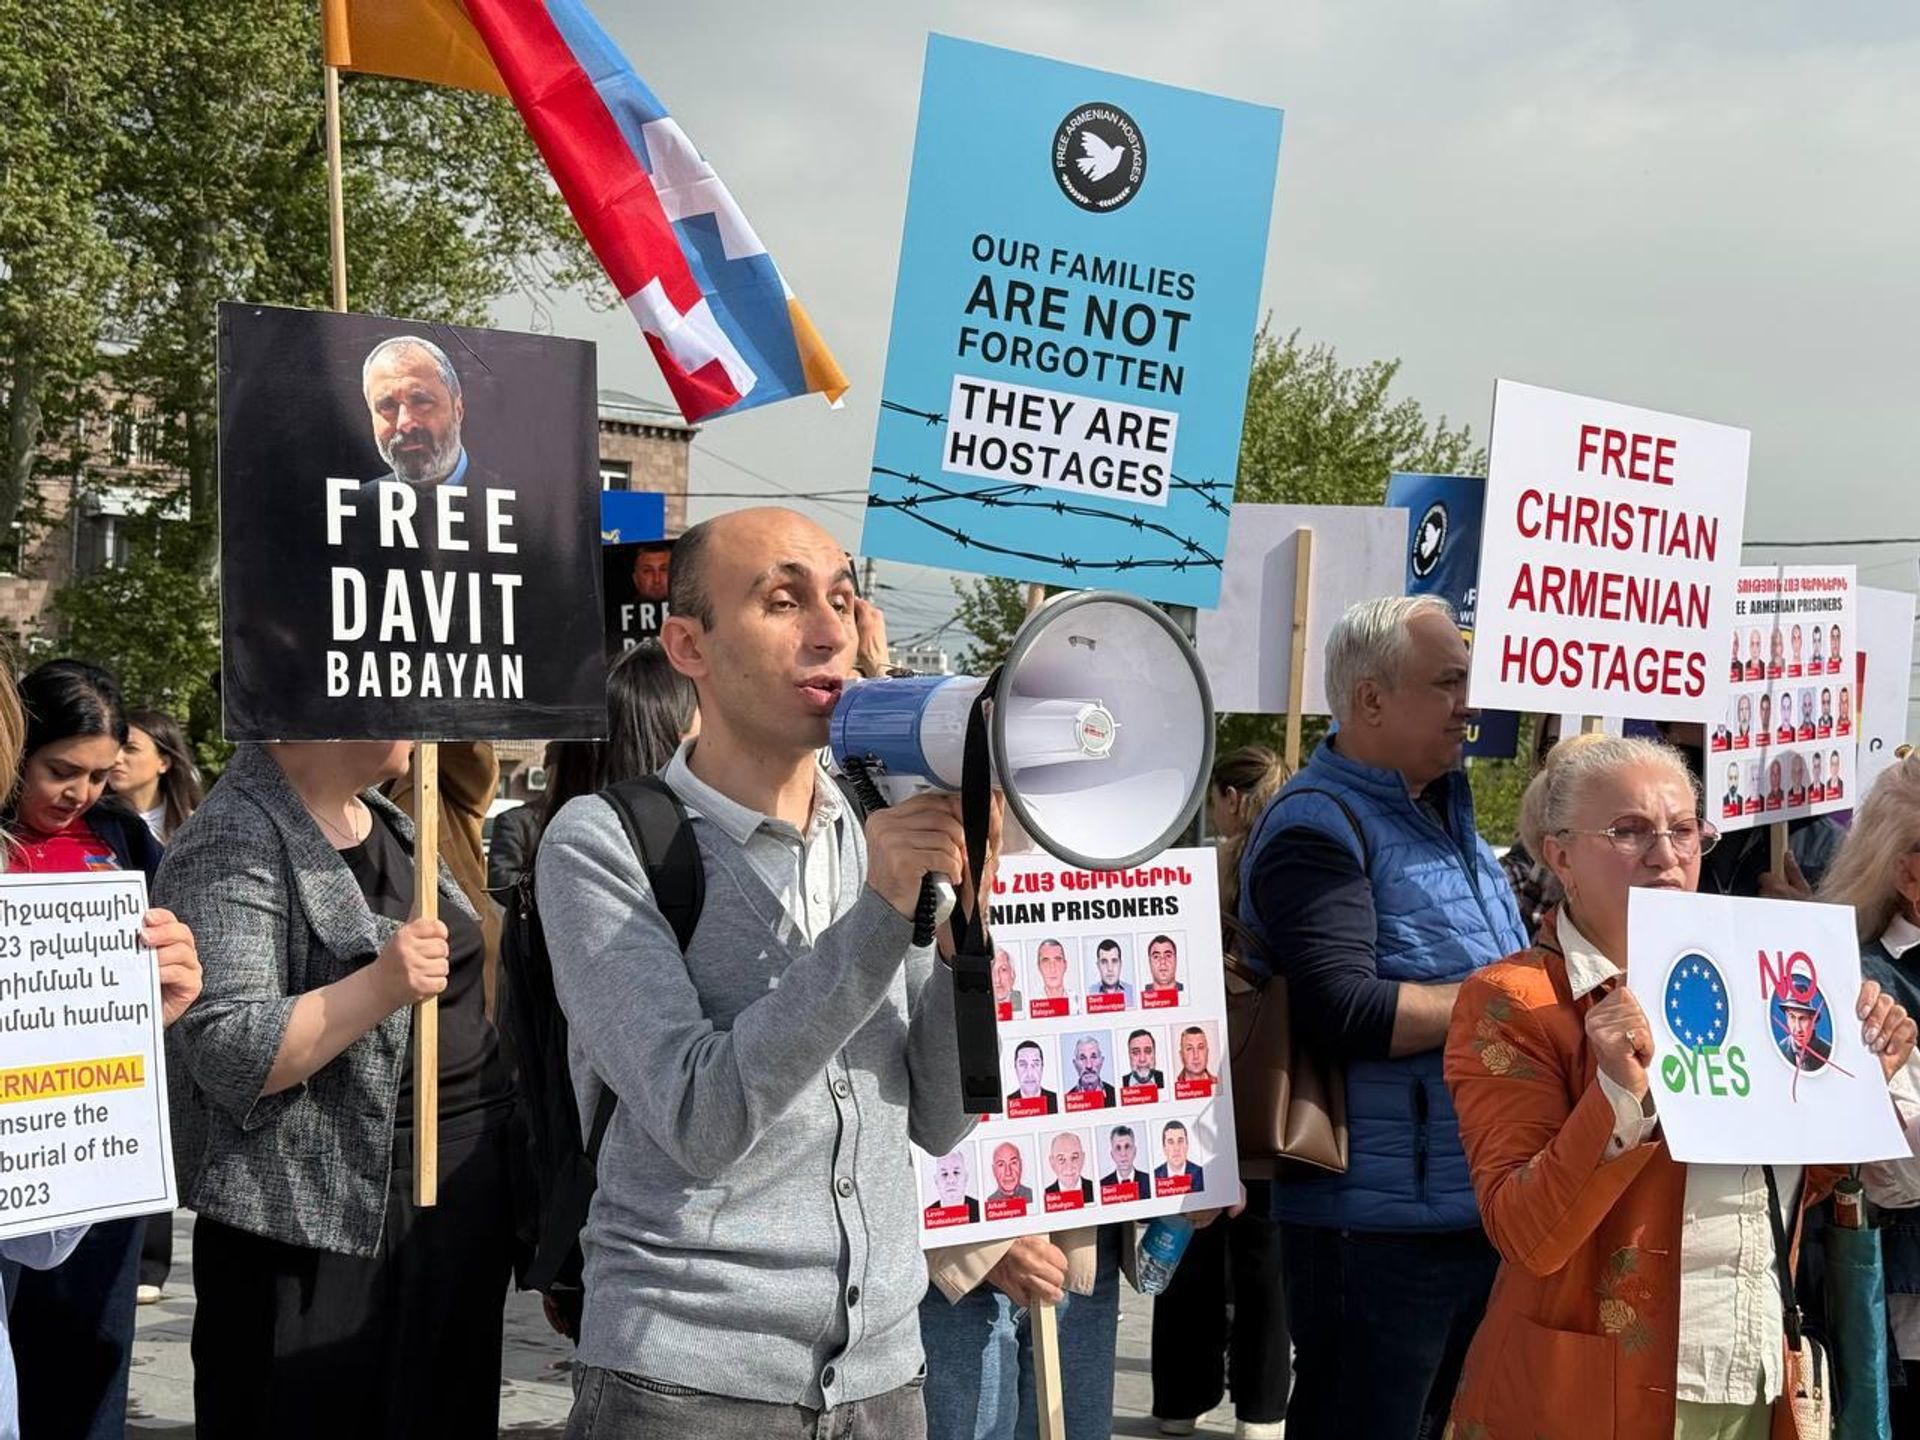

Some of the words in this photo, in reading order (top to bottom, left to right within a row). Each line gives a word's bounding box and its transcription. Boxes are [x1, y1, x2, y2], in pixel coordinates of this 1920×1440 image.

[1056, 134, 1070, 168] FREE
[1065, 109, 1119, 136] ARMENIAN
[1117, 118, 1143, 183] HOSTAGES
[973, 234, 1039, 271] OUR
[1050, 249, 1195, 300] FAMILIES
[965, 275, 1068, 331] ARE
[1084, 295, 1191, 352] NOT
[959, 327, 1184, 395] FORGOTTEN
[960, 384, 1075, 434] THEY
[1085, 408, 1170, 452] ARE
[950, 432, 1163, 496] HOSTAGES
[1578, 424, 1676, 485] FREE
[327, 478, 518, 553] FREE
[1517, 489, 1717, 561] CHRISTIAN
[331, 567, 522, 645] DAVIT
[1509, 564, 1710, 629] ARMENIAN
[1750, 599, 1795, 614] ARMENIAN
[1797, 597, 1843, 612] PRISONERS
[326, 651, 524, 699] BABAYAN
[1501, 636, 1706, 698] HOSTAGES
[1012, 872, 1055, 893] ՀԱՅ
[1060, 866, 1192, 891] ԳԵՐԻՆԵՐԻՆ
[0, 894, 139, 927] իջազգային
[1052, 895, 1179, 922] PRISONERS
[101, 966, 119, 987] և
[1758, 950, 1817, 1003] NO
[0, 1007, 55, 1032] ման
[64, 1001, 148, 1025] համար
[0, 1061, 144, 1098] RNATIONAL
[1675, 1044, 1751, 1097] YES
[0, 1111, 66, 1135] nsure
[74, 1103, 108, 1125] the
[0, 1142, 66, 1173] burial
[74, 1138, 96, 1162] of
[102, 1135, 139, 1158] the
[0, 1182, 50, 1211] 2023
